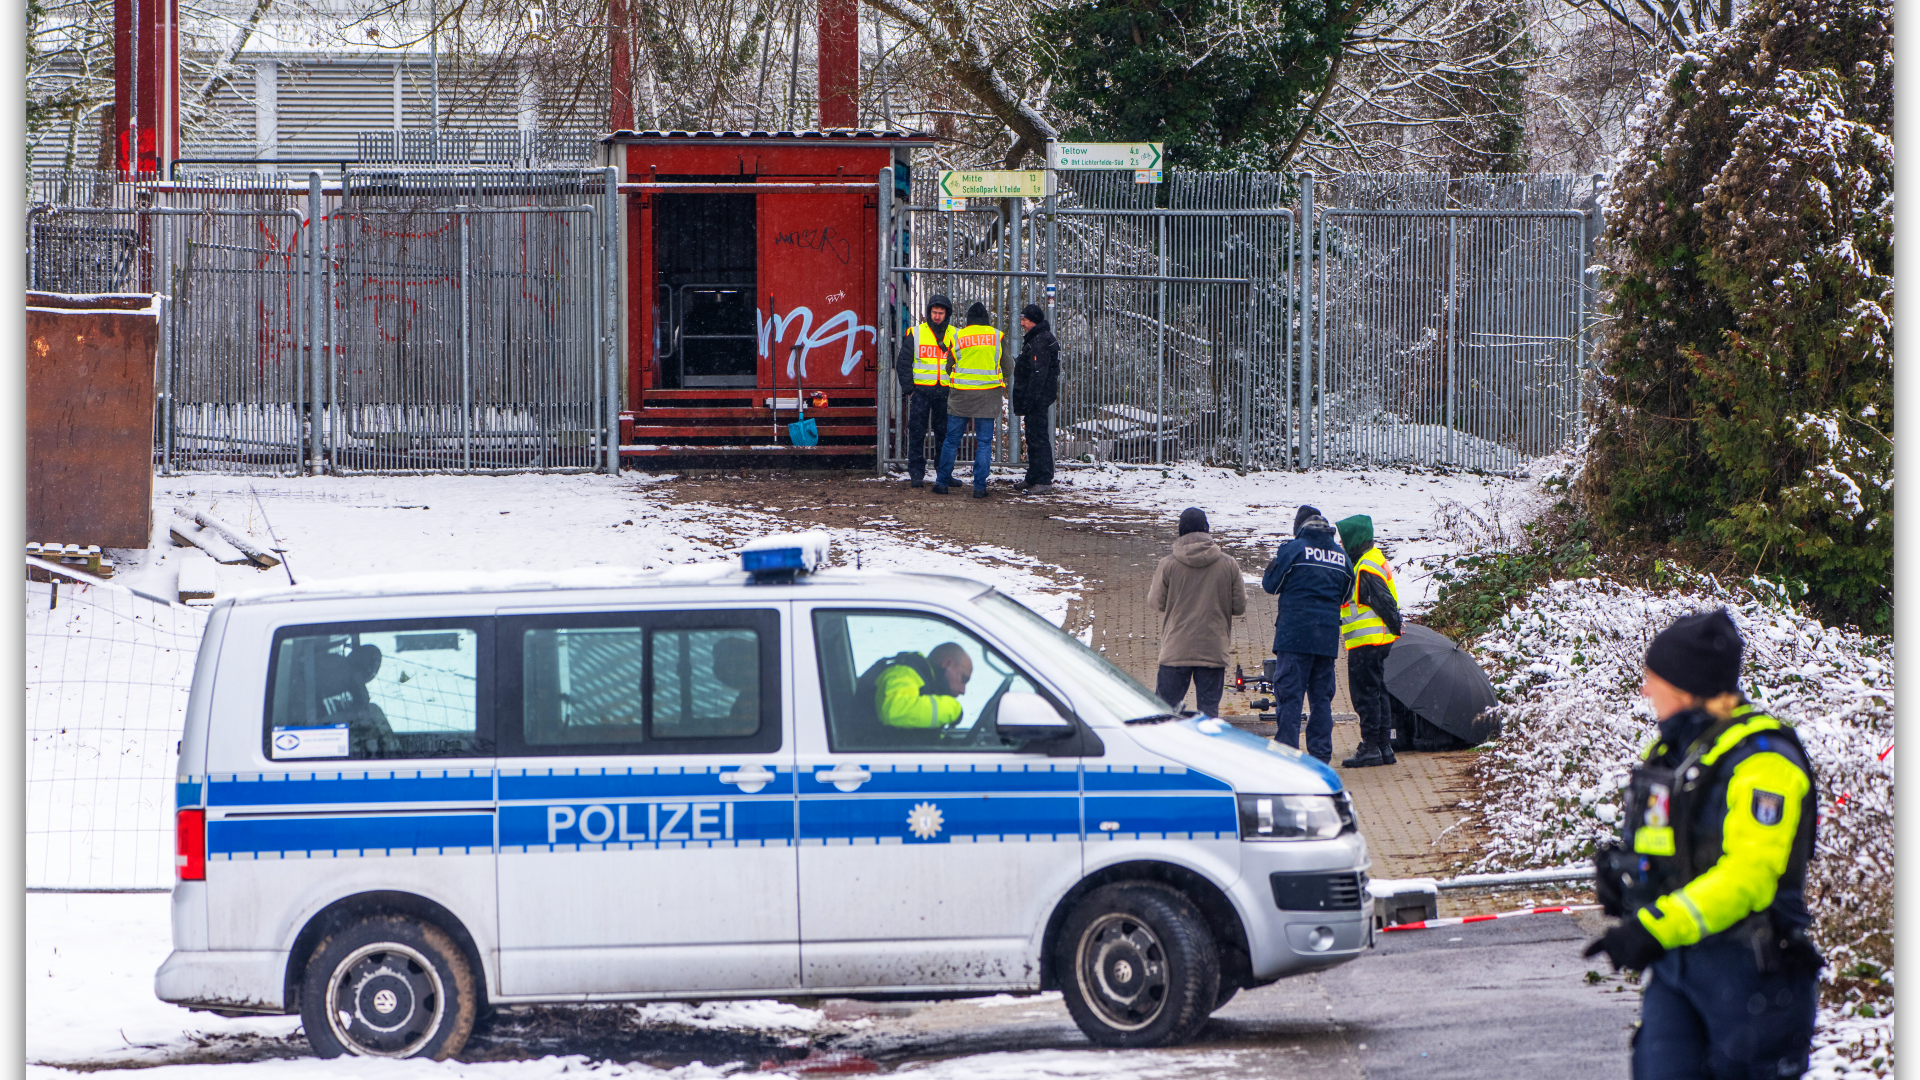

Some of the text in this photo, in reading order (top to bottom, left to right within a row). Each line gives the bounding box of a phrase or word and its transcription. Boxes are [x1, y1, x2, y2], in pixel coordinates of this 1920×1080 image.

[1061, 146, 1087, 155] Teltow
[962, 174, 1036, 182] Mitte 13
[962, 185, 998, 195] Schloßpark
[960, 334, 994, 349] POLIZEI
[920, 345, 948, 359] POLIZ
[1304, 546, 1346, 567] POLIZEI
[547, 802, 734, 844] POLIZEI
